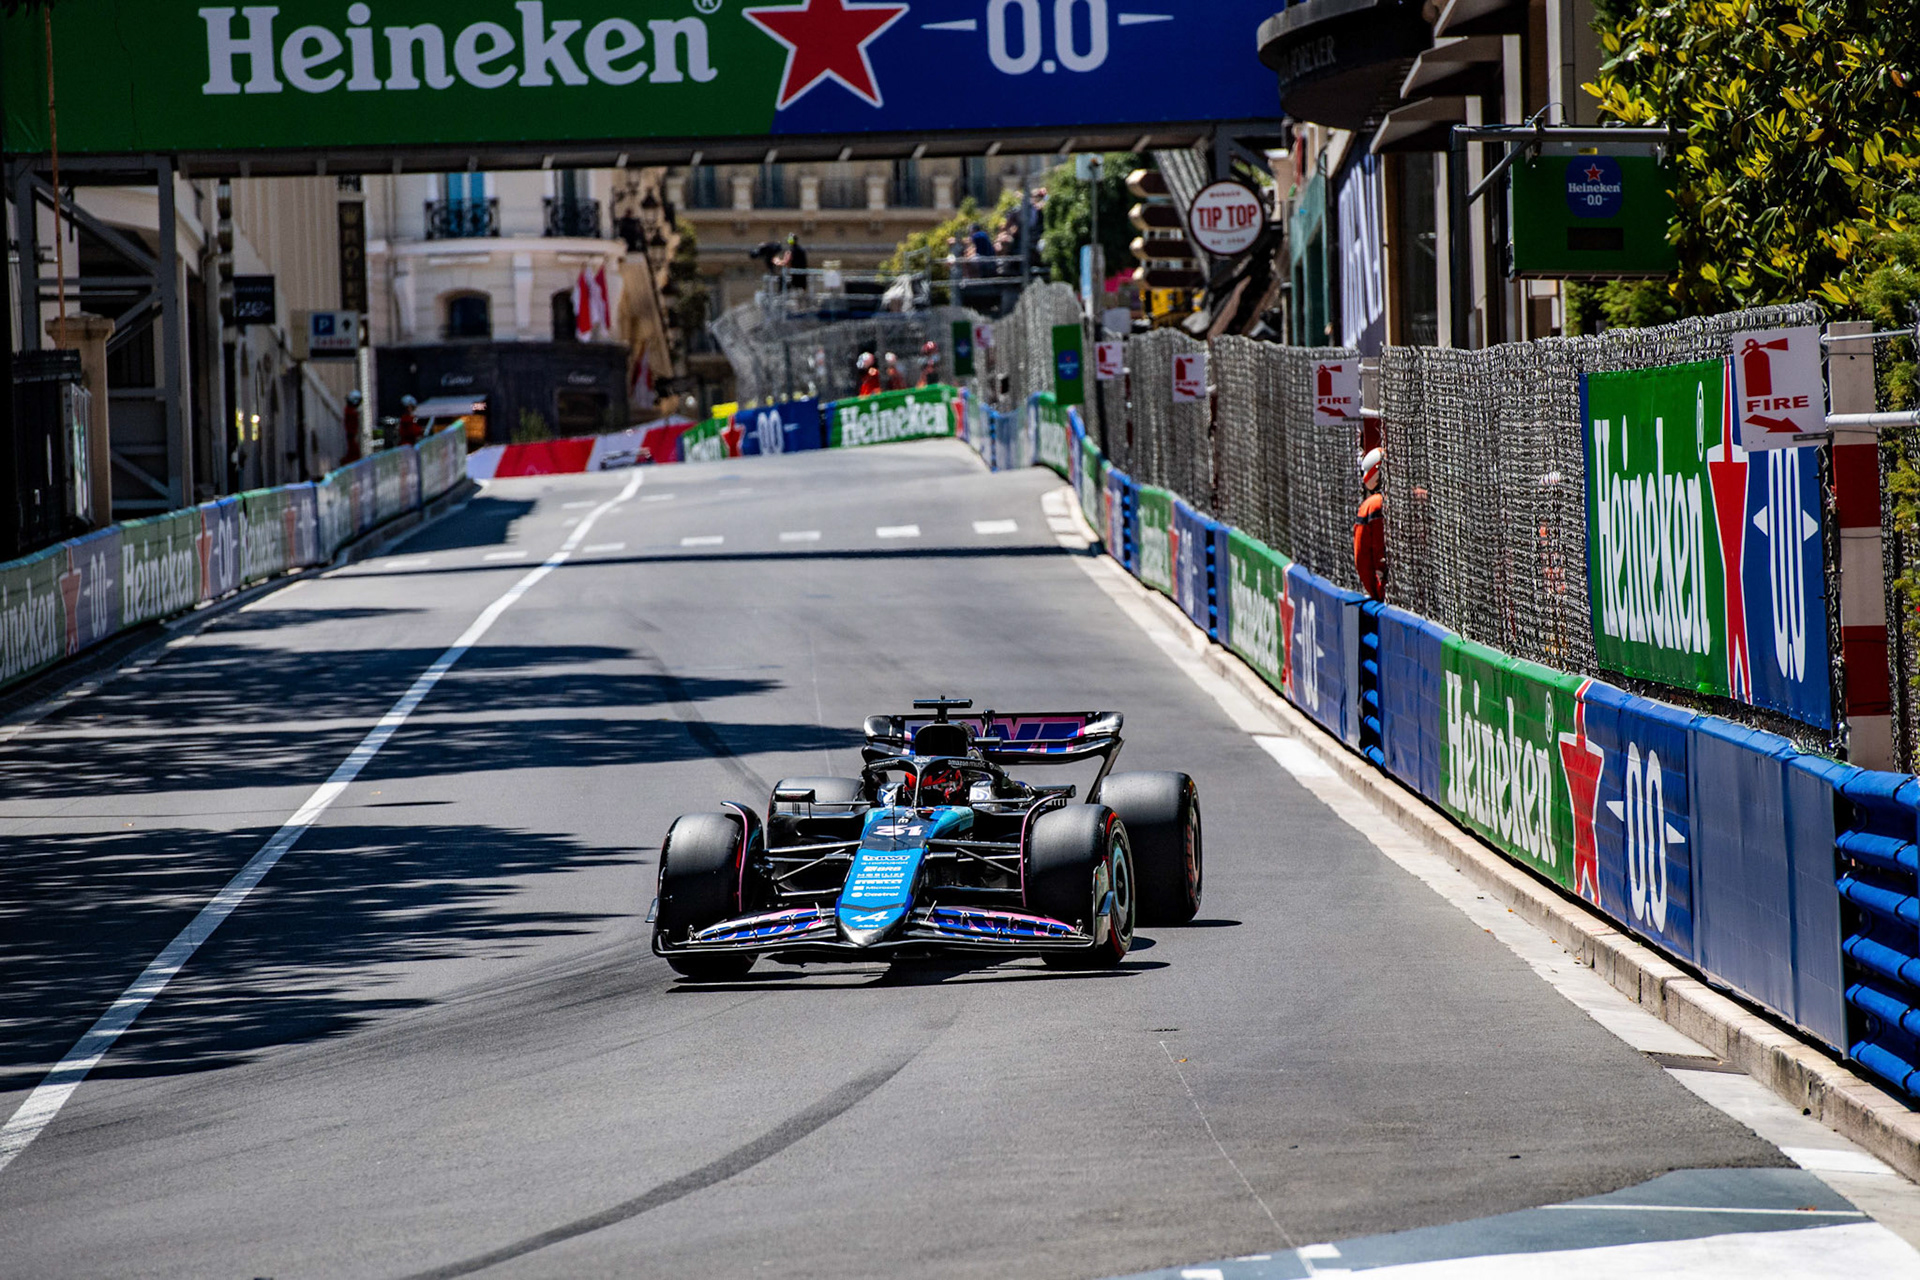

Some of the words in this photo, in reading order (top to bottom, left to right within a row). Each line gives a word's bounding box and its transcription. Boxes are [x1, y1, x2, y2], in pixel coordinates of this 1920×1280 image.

[199, 0, 718, 94] Heineken
[1568, 182, 1620, 193] Heineken
[1197, 206, 1222, 228] TIP
[1226, 204, 1257, 227] TOP
[1318, 396, 1352, 405] FIRE
[1747, 395, 1810, 413] FIRE
[840, 395, 949, 447] Heineken
[1594, 417, 1709, 655] Heineken
[123, 535, 193, 624] Heineken
[1446, 671, 1556, 869] Heineken
[873, 825, 923, 836] 31
